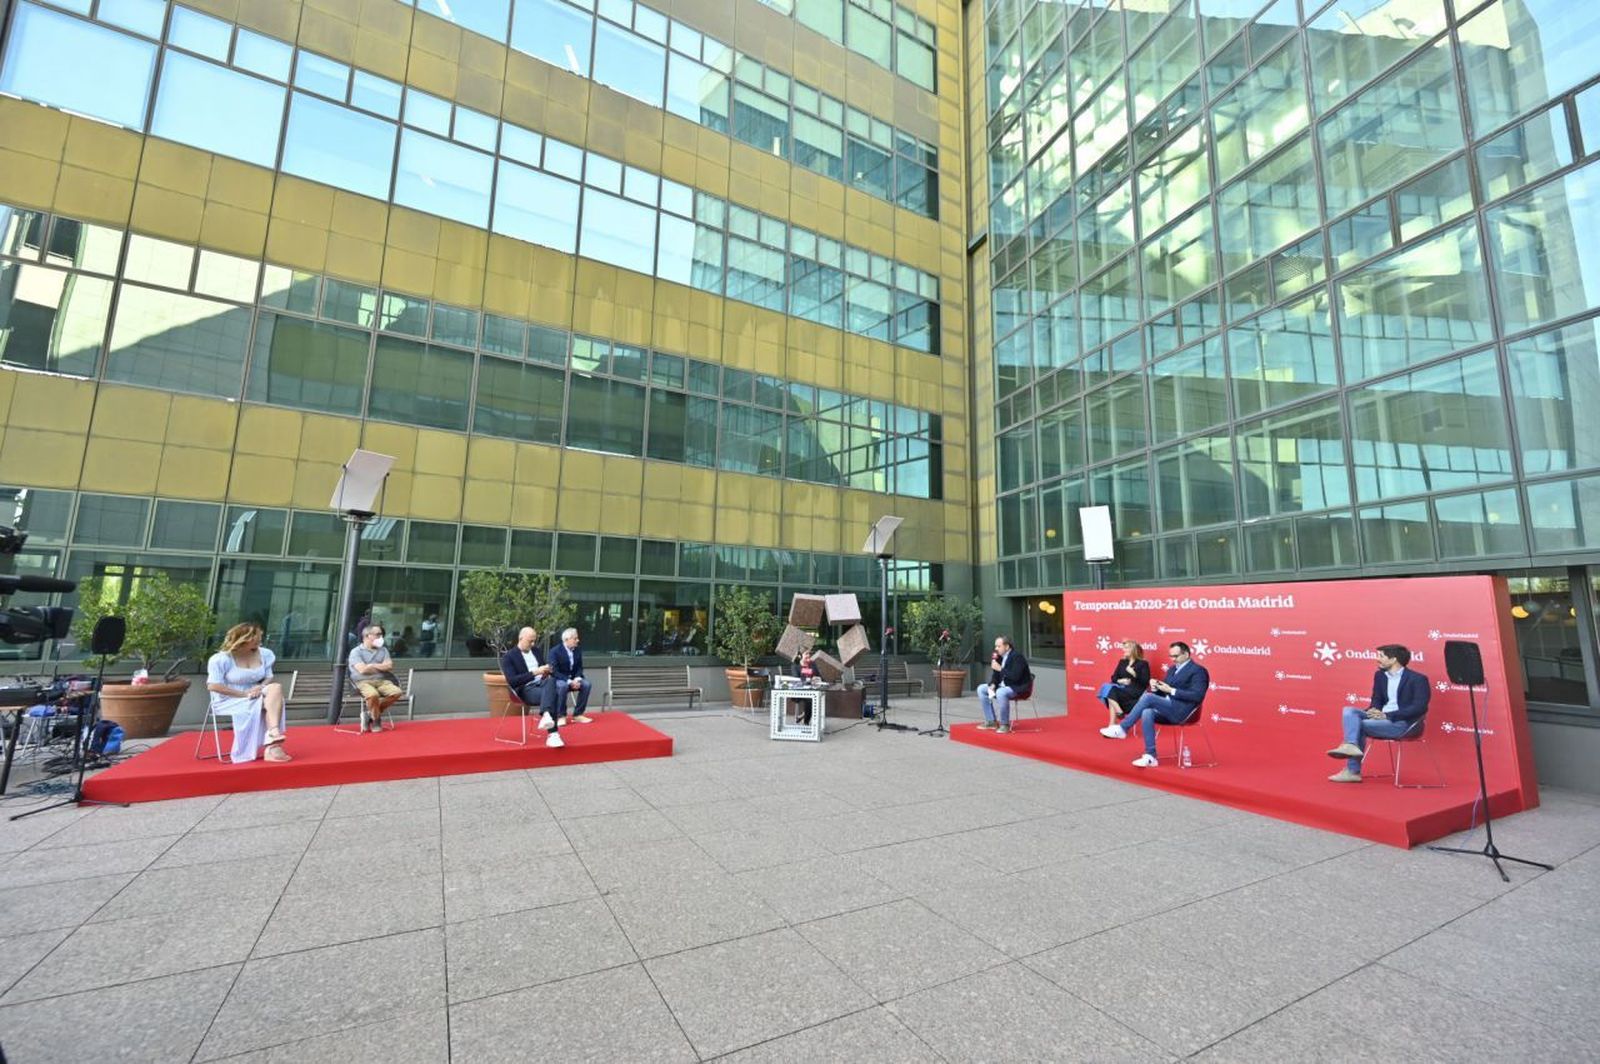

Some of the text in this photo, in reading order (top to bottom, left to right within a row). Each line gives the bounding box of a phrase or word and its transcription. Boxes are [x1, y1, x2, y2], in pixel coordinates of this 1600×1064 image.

[1073, 595, 1294, 613] Temporada 2020-21 de Onda Madrid
[1213, 644, 1271, 656] OndaMadrid
